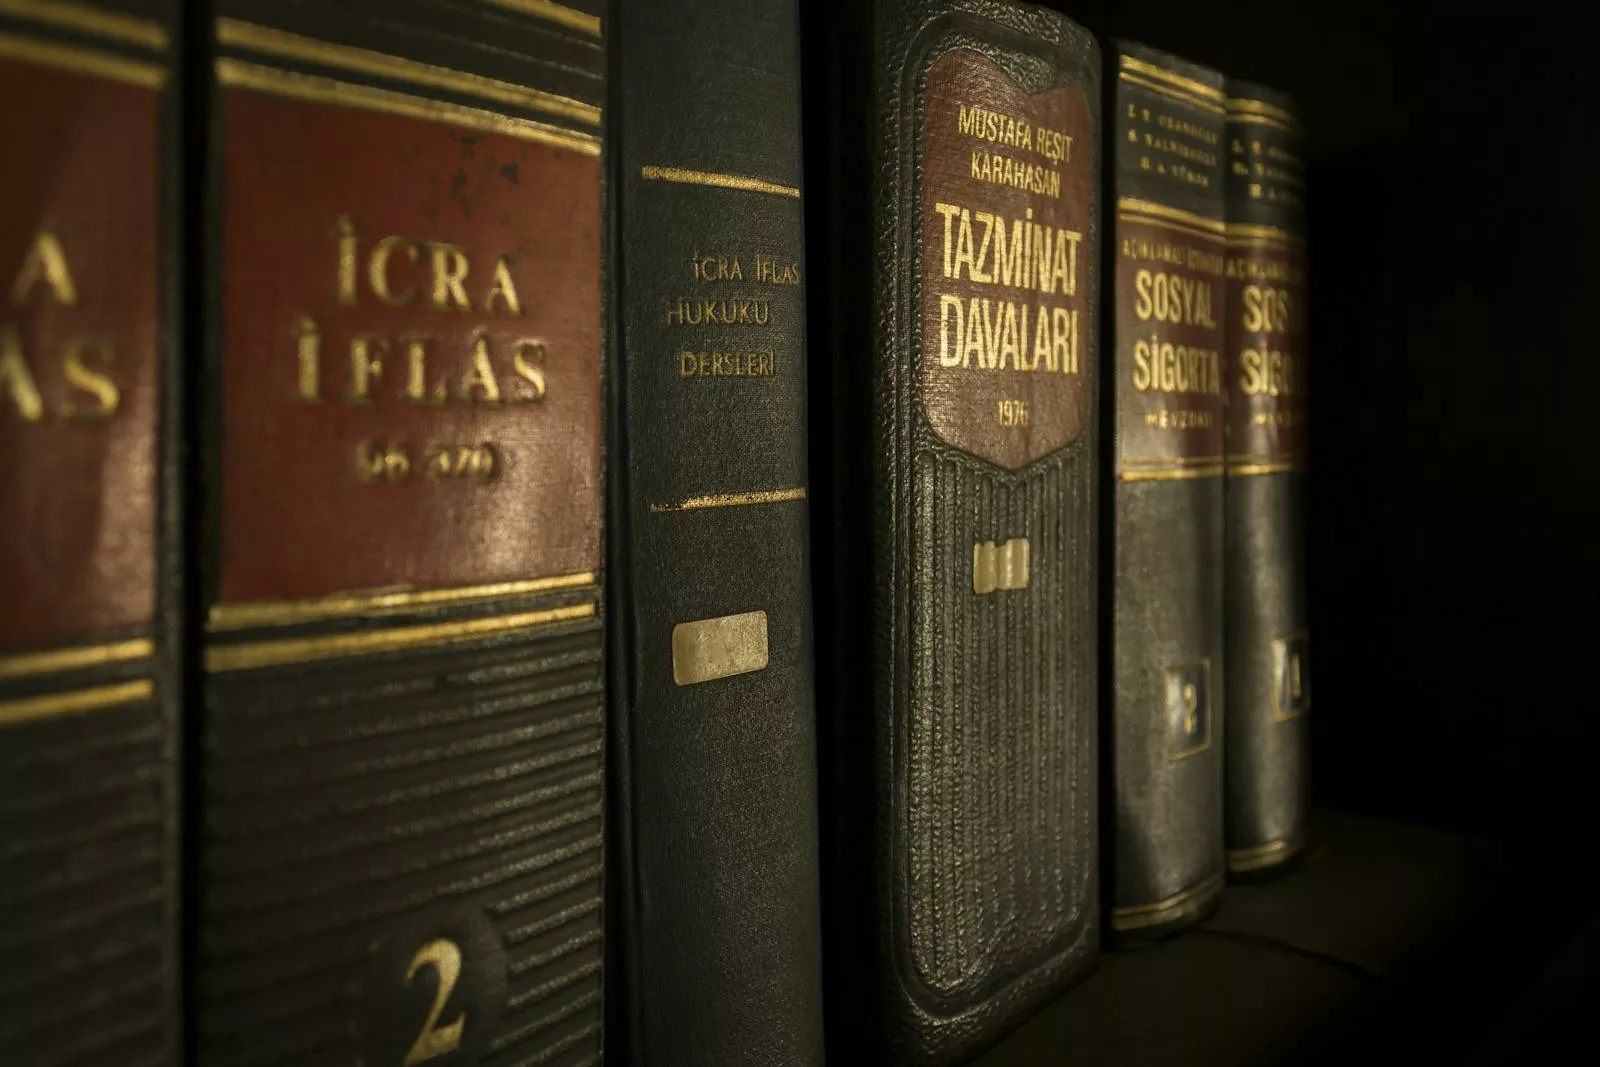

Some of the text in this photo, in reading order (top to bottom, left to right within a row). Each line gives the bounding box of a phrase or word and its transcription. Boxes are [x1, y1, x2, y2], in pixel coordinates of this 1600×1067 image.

[958, 104, 1032, 150] MUSTAFA
[971, 152, 1060, 199] KARAHASAN
[336, 214, 523, 315] İCRA
[692, 247, 743, 281] İCRA
[935, 202, 1082, 296] TAZMİNAT
[666, 298, 769, 325] HUKUKU
[1135, 268, 1216, 330] SOSYAL
[939, 293, 1079, 375] DAVALARI
[1132, 332, 1220, 394] SİGORTA
[998, 399, 1028, 428] 1976
[403, 938, 467, 1067] 2
